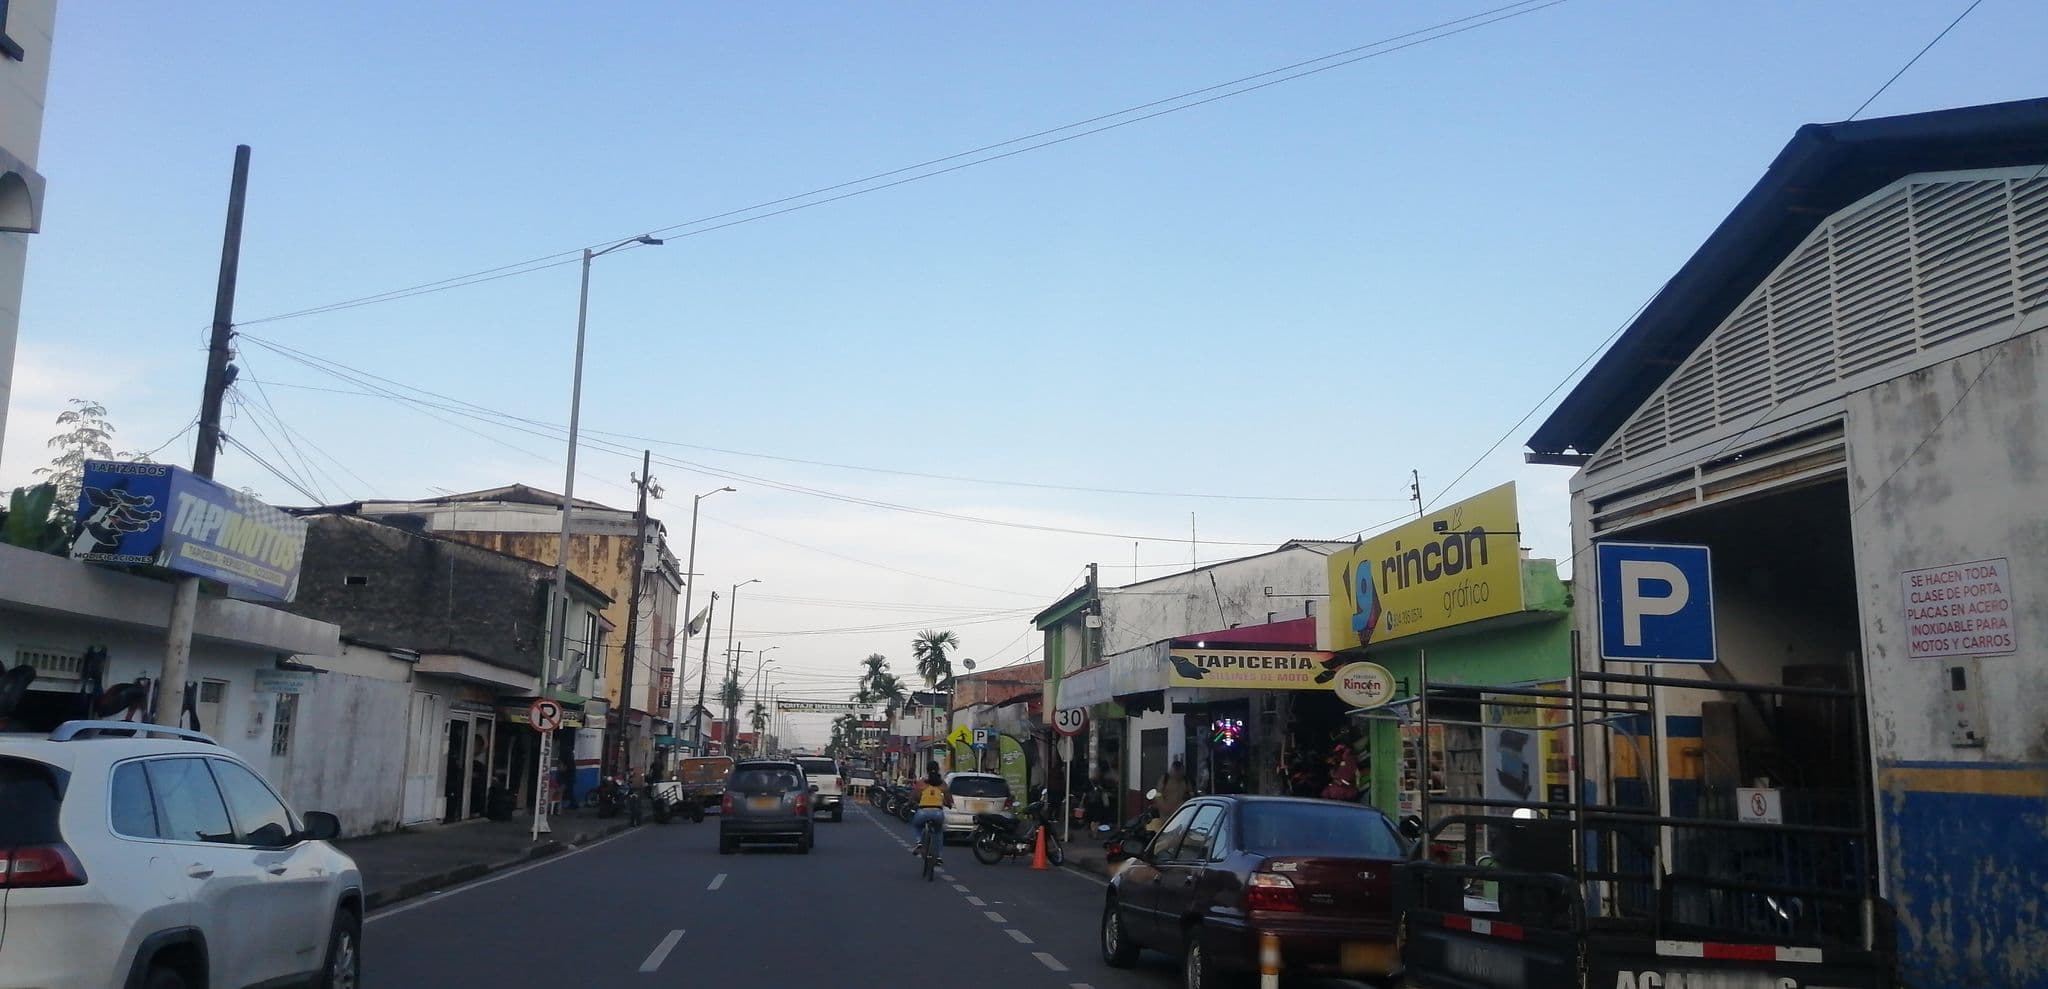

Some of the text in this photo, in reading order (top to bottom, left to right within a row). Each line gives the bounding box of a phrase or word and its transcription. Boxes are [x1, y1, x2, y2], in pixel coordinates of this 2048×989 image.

[91, 462, 167, 476] TAPIZADOS
[171, 490, 298, 572] TAPIMOTOS
[73, 552, 154, 563] MODIFICACIONES
[1911, 566, 1997, 587] SE HACEN TODA
[1911, 582, 2001, 604] CLASE DE PORTA
[1620, 559, 1689, 647] P
[1908, 599, 2009, 620] PLACAS EN ACERO
[1912, 617, 2008, 636] INOXIDABLE PARA
[1912, 634, 2011, 652] MOTOS Y CARROS
[1194, 653, 1313, 670] TAPICERÍA
[1260, 672, 1273, 681] DE
[1277, 672, 1309, 682] MOTO
[662, 676, 672, 707] HOTEL
[1059, 709, 1081, 726] 30
[976, 731, 985, 740] P
